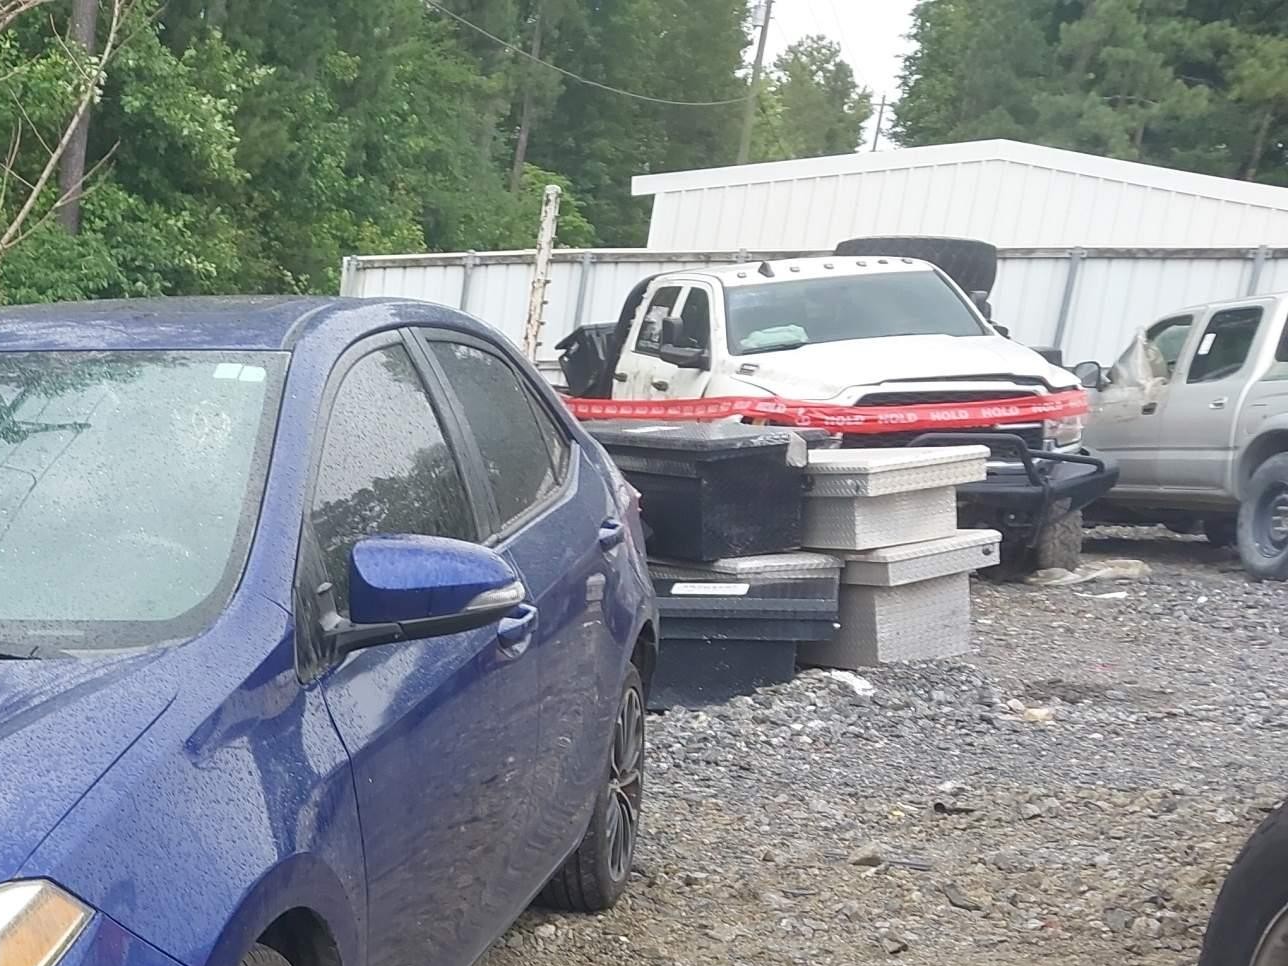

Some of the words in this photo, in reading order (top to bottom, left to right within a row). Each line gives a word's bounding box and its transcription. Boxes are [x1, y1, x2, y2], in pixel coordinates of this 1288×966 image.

[877, 412, 918, 424] HOLD
[929, 410, 969, 421] HOLD
[981, 406, 1020, 418] HOLD
